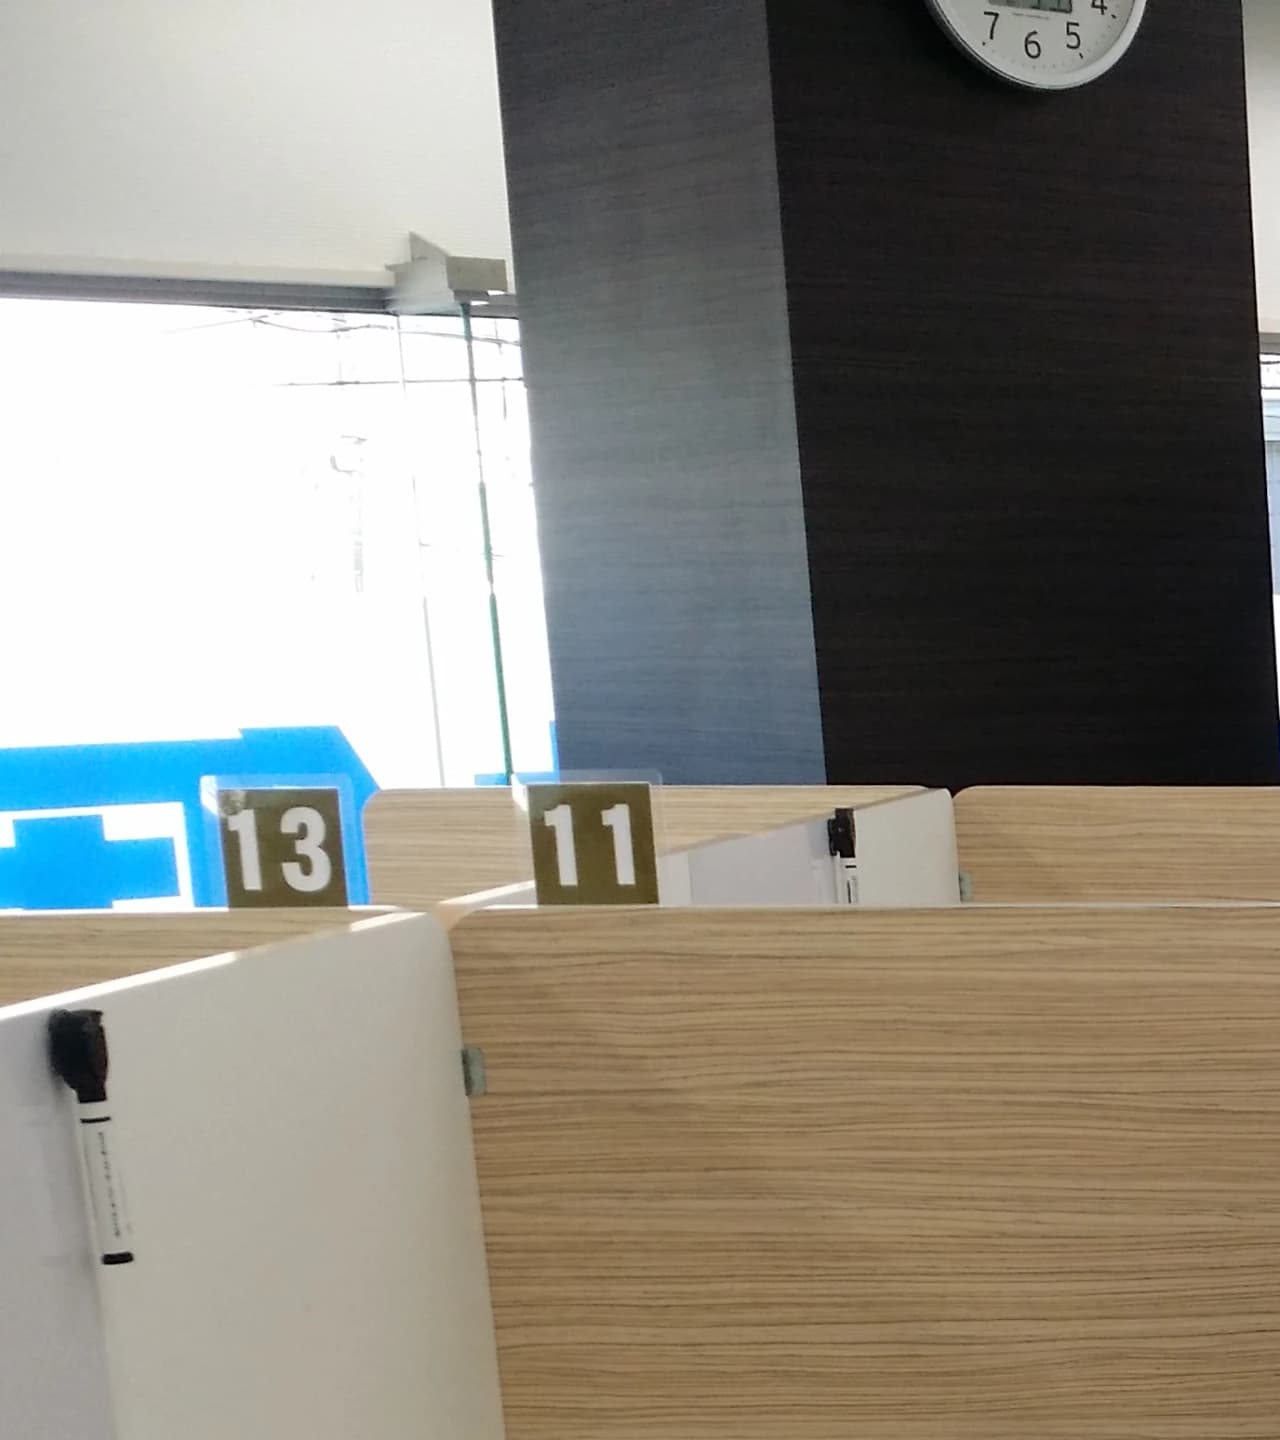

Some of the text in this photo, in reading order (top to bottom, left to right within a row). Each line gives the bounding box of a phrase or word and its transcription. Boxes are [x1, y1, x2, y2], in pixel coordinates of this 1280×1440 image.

[984, 11, 999, 40] 7
[1066, 22, 1081, 50] 5
[1024, 30, 1041, 59] 6
[227, 805, 332, 893] 13
[543, 803, 636, 887] 11
